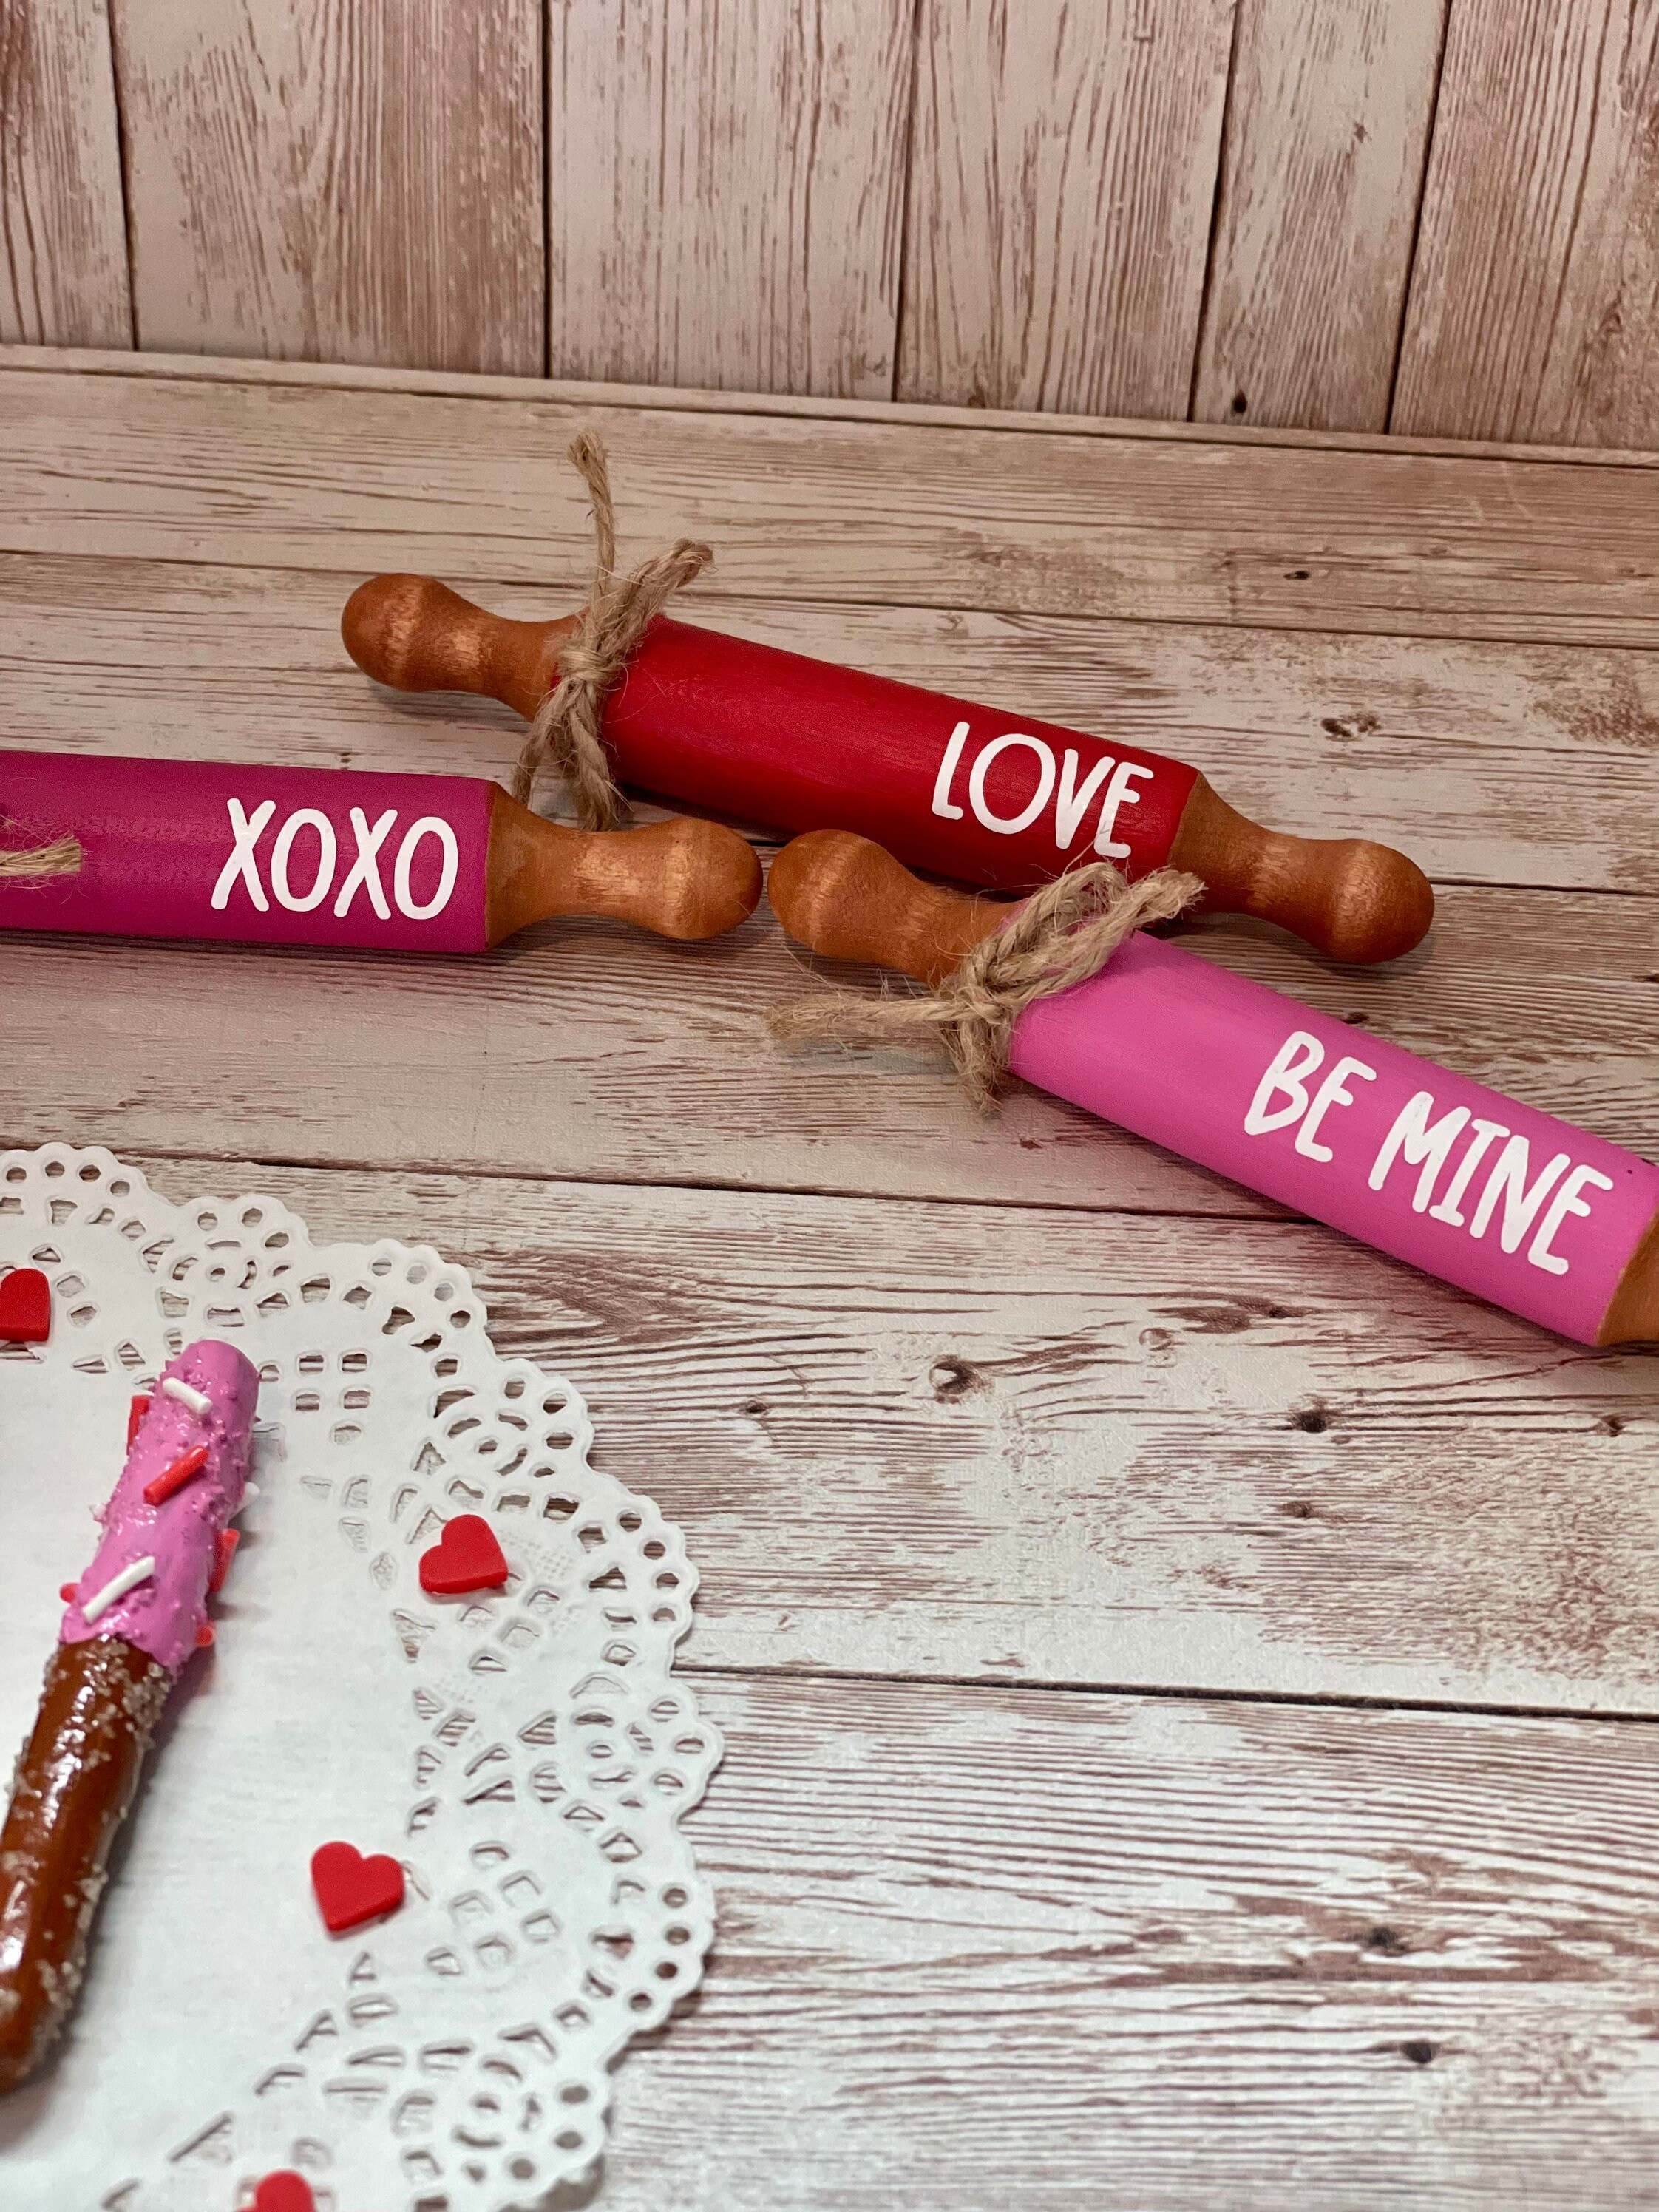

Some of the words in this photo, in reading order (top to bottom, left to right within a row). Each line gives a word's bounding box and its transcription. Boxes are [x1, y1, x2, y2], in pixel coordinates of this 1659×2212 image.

[211, 798, 459, 920] XOXO
[932, 721, 1154, 859] LOVE
[1244, 1030, 1377, 1163] BE
[1367, 1090, 1615, 1276] MINE
